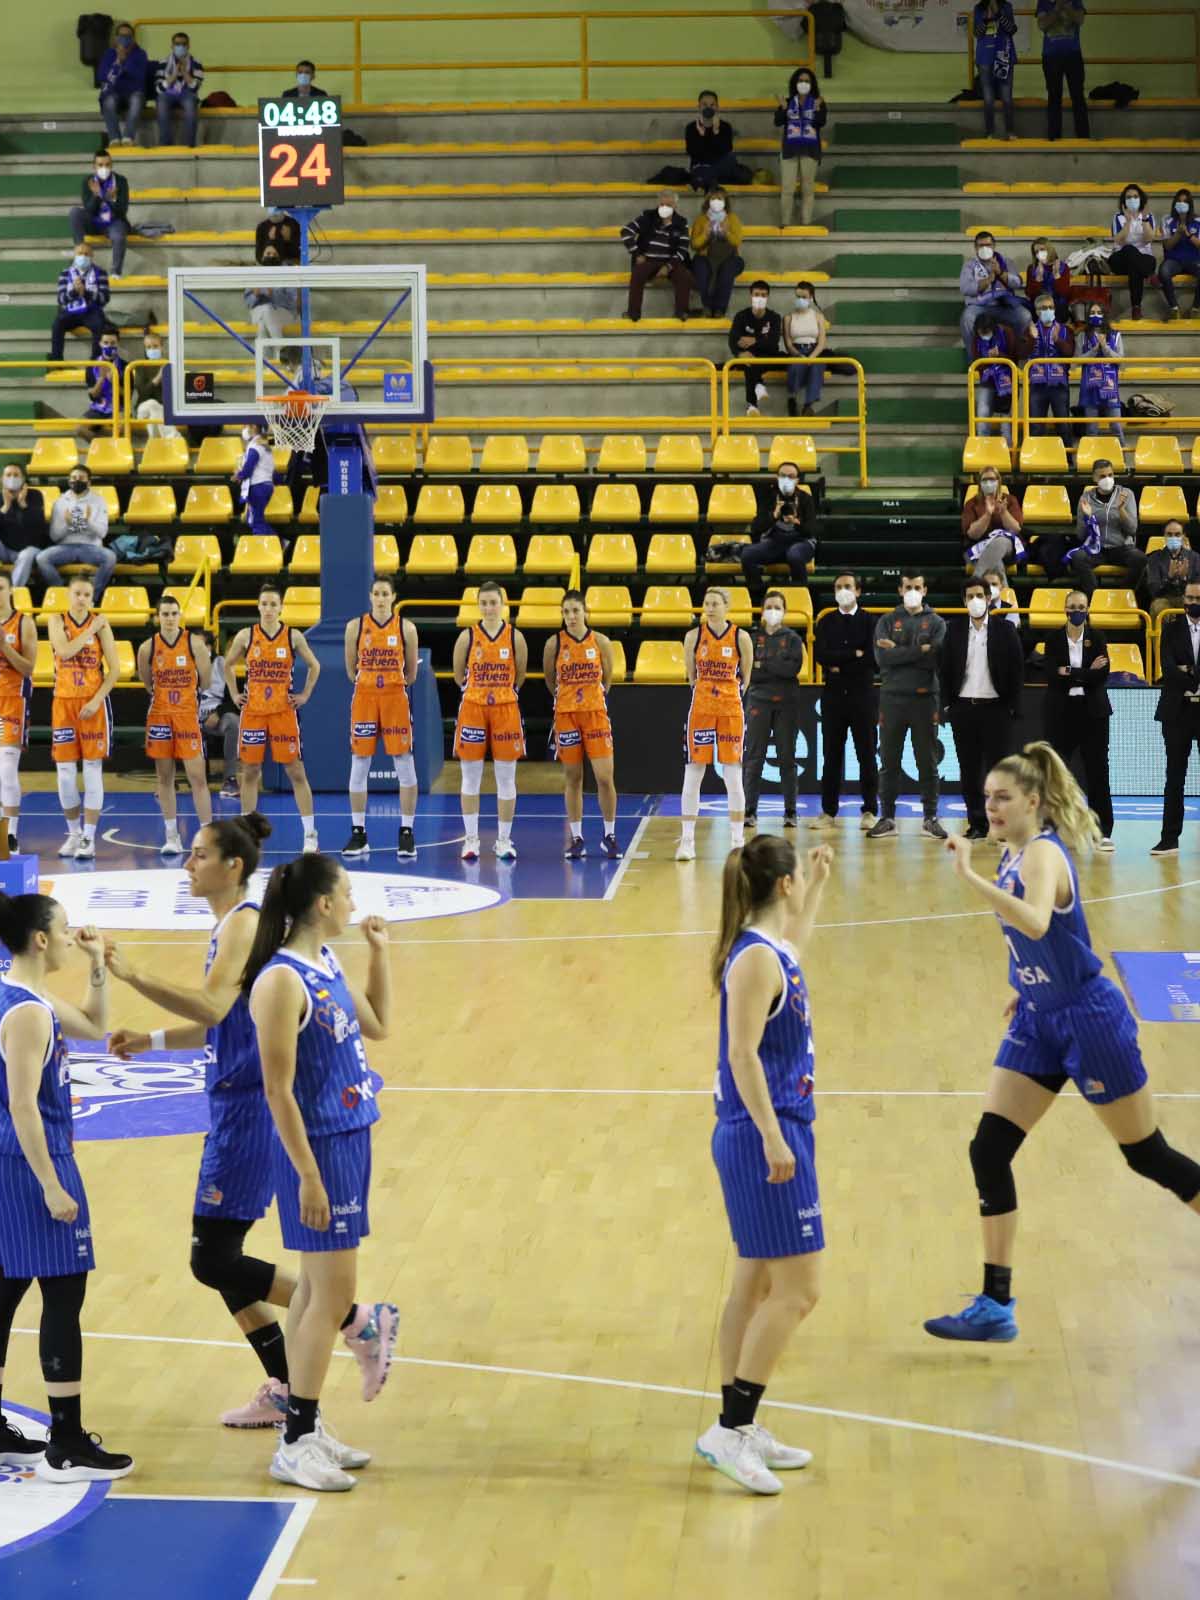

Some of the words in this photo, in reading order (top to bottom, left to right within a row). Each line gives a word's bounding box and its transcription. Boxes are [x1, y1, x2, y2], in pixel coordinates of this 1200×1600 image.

[264, 101, 338, 126] 04:48
[269, 143, 332, 188] 24
[339, 460, 349, 495] MONDO
[362, 648, 393, 657] Cultura
[250, 660, 283, 669] Cultura
[472, 662, 506, 671] Cultura
[561, 662, 594, 673] Cultura
[700, 660, 732, 670] Cultura
[73, 672, 85, 687] 12
[376, 675, 385, 689] 8
[168, 690, 181, 705] 10
[264, 686, 273, 700] 9
[487, 691, 496, 705] 6
[576, 687, 584, 703] 5
[711, 685, 720, 698] 4
[381, 725, 408, 736] teika
[269, 733, 296, 743] teika
[369, 771, 399, 780] MOND
